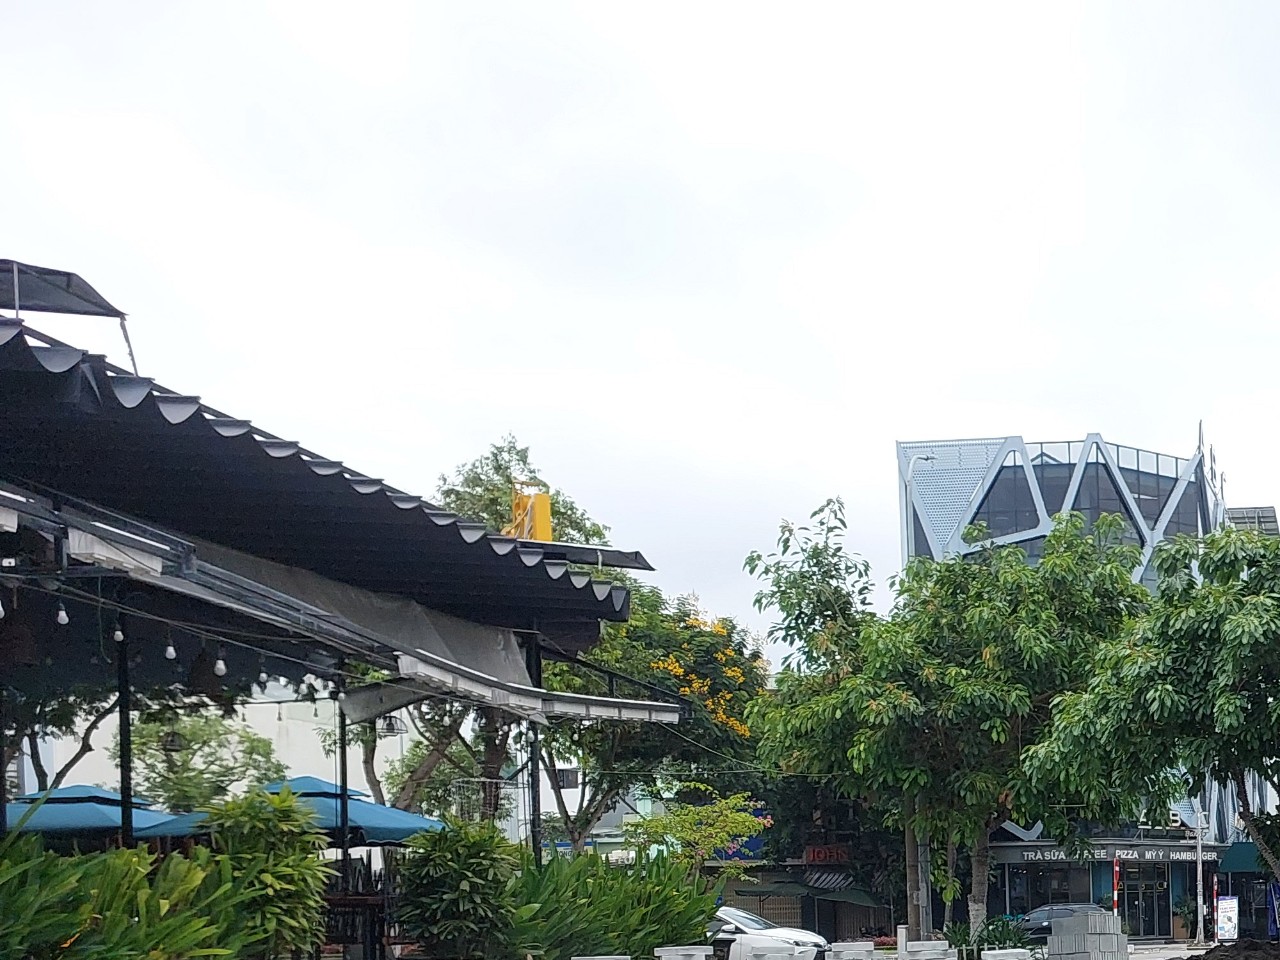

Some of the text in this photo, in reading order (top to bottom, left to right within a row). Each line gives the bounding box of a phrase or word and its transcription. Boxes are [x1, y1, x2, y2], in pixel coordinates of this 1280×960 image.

[1022, 850, 1044, 860] TRÀ
[1115, 849, 1139, 859] PIZZA
[1170, 851, 1217, 860] HAMBUGER
